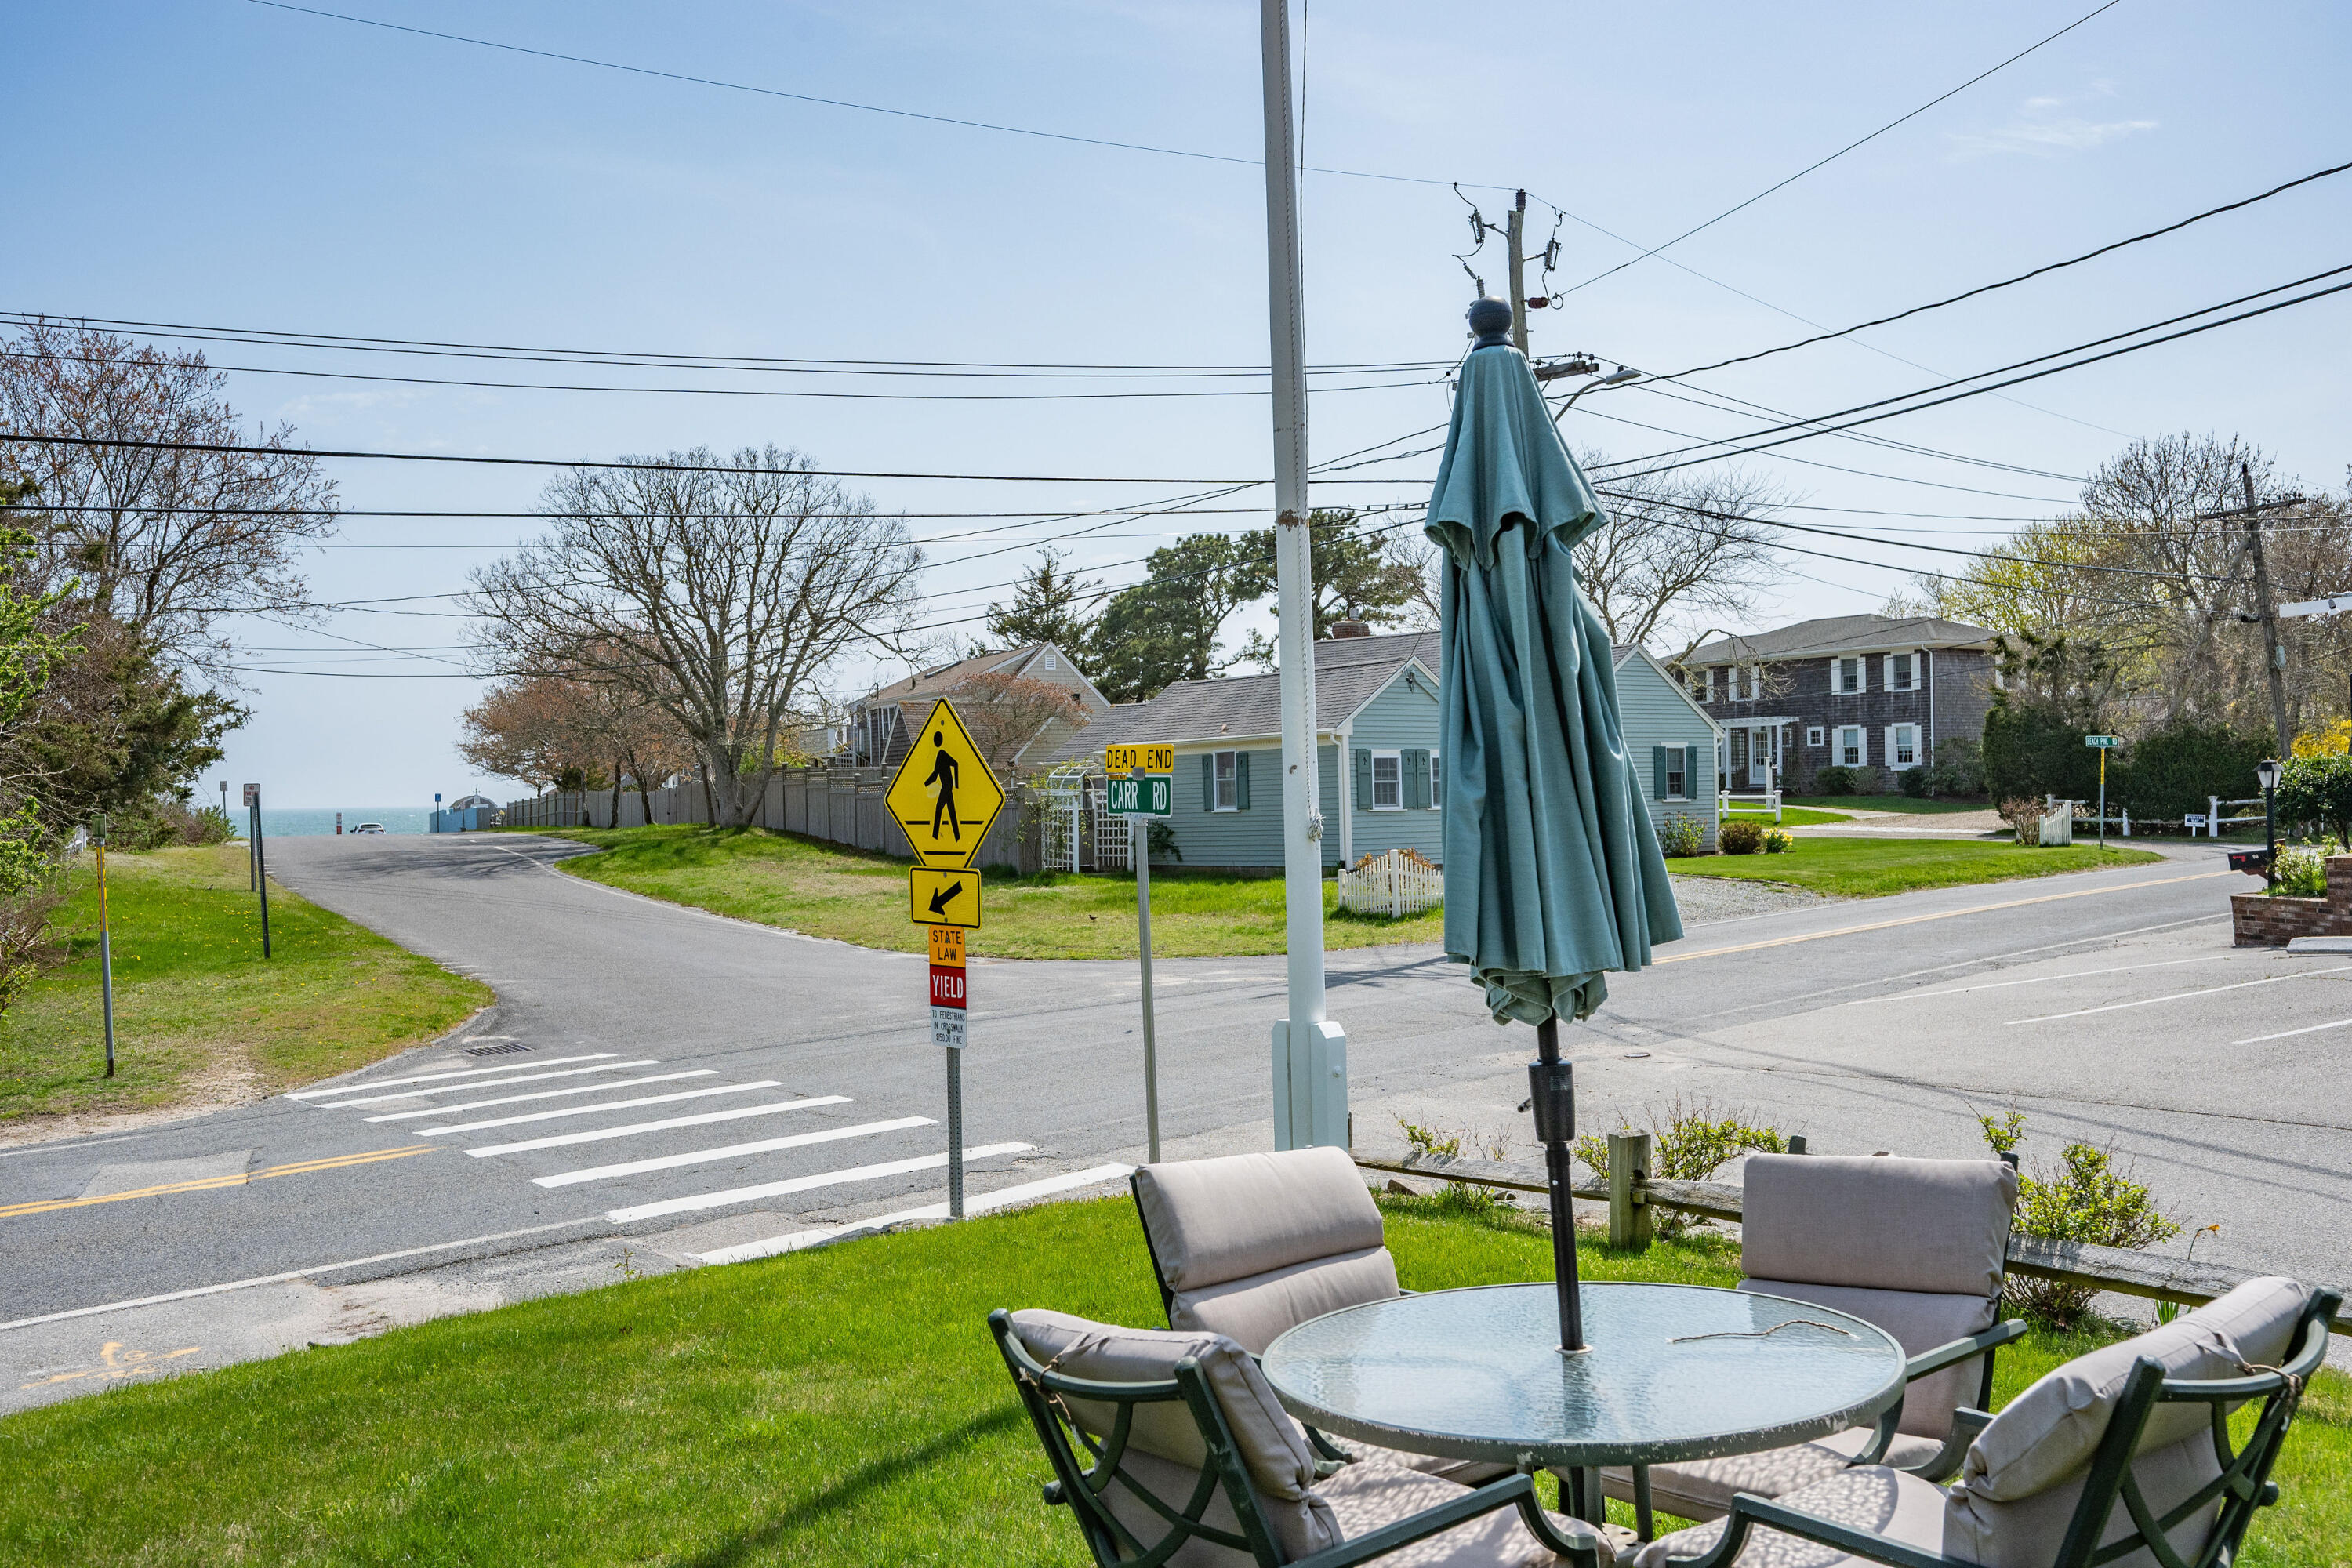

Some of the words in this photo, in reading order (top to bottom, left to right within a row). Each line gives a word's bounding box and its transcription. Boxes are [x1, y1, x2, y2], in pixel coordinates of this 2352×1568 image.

[2087, 737, 2099, 746] BEACH
[1107, 749, 1137, 768] DEAD
[1147, 749, 1172, 768] END
[1111, 780, 1138, 810] CARR
[1152, 781, 1167, 811] RD
[932, 930, 962, 945] STATE
[938, 947, 956, 961] LAW
[932, 975, 964, 999] YIELD
[931, 1009, 938, 1018] TO
[939, 1010, 965, 1022] PEDESTRIANS
[941, 1022, 964, 1033] CROSSWALK
[936, 1033, 951, 1043] $150.00
[953, 1034, 962, 1044] FINE
